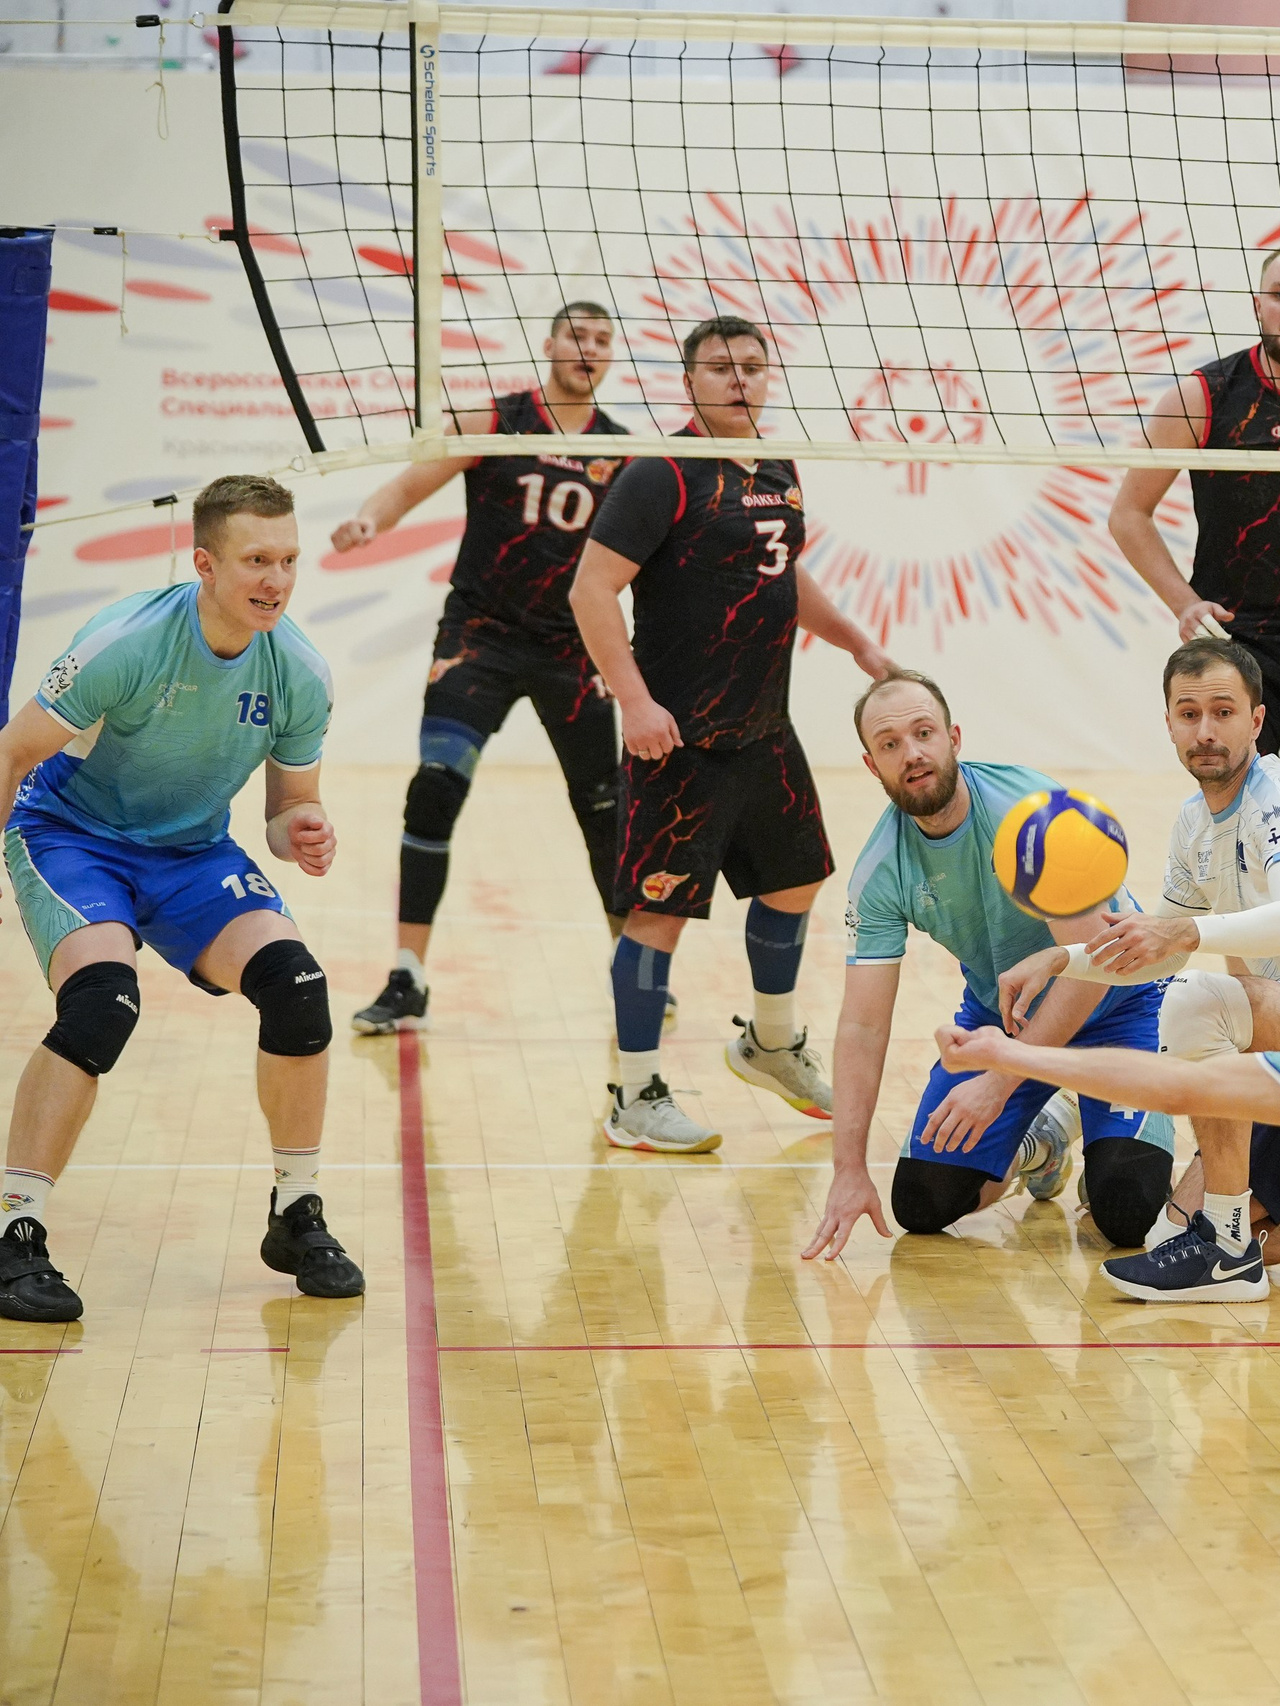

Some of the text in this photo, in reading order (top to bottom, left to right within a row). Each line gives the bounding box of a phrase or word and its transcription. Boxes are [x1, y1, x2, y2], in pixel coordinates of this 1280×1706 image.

[422, 61, 437, 176] Schelde Sports
[516, 472, 595, 532] 10
[754, 519, 790, 576] 3
[236, 690, 270, 728] 18
[221, 873, 276, 900] 18
[1227, 1206, 1242, 1242] MIKASA
